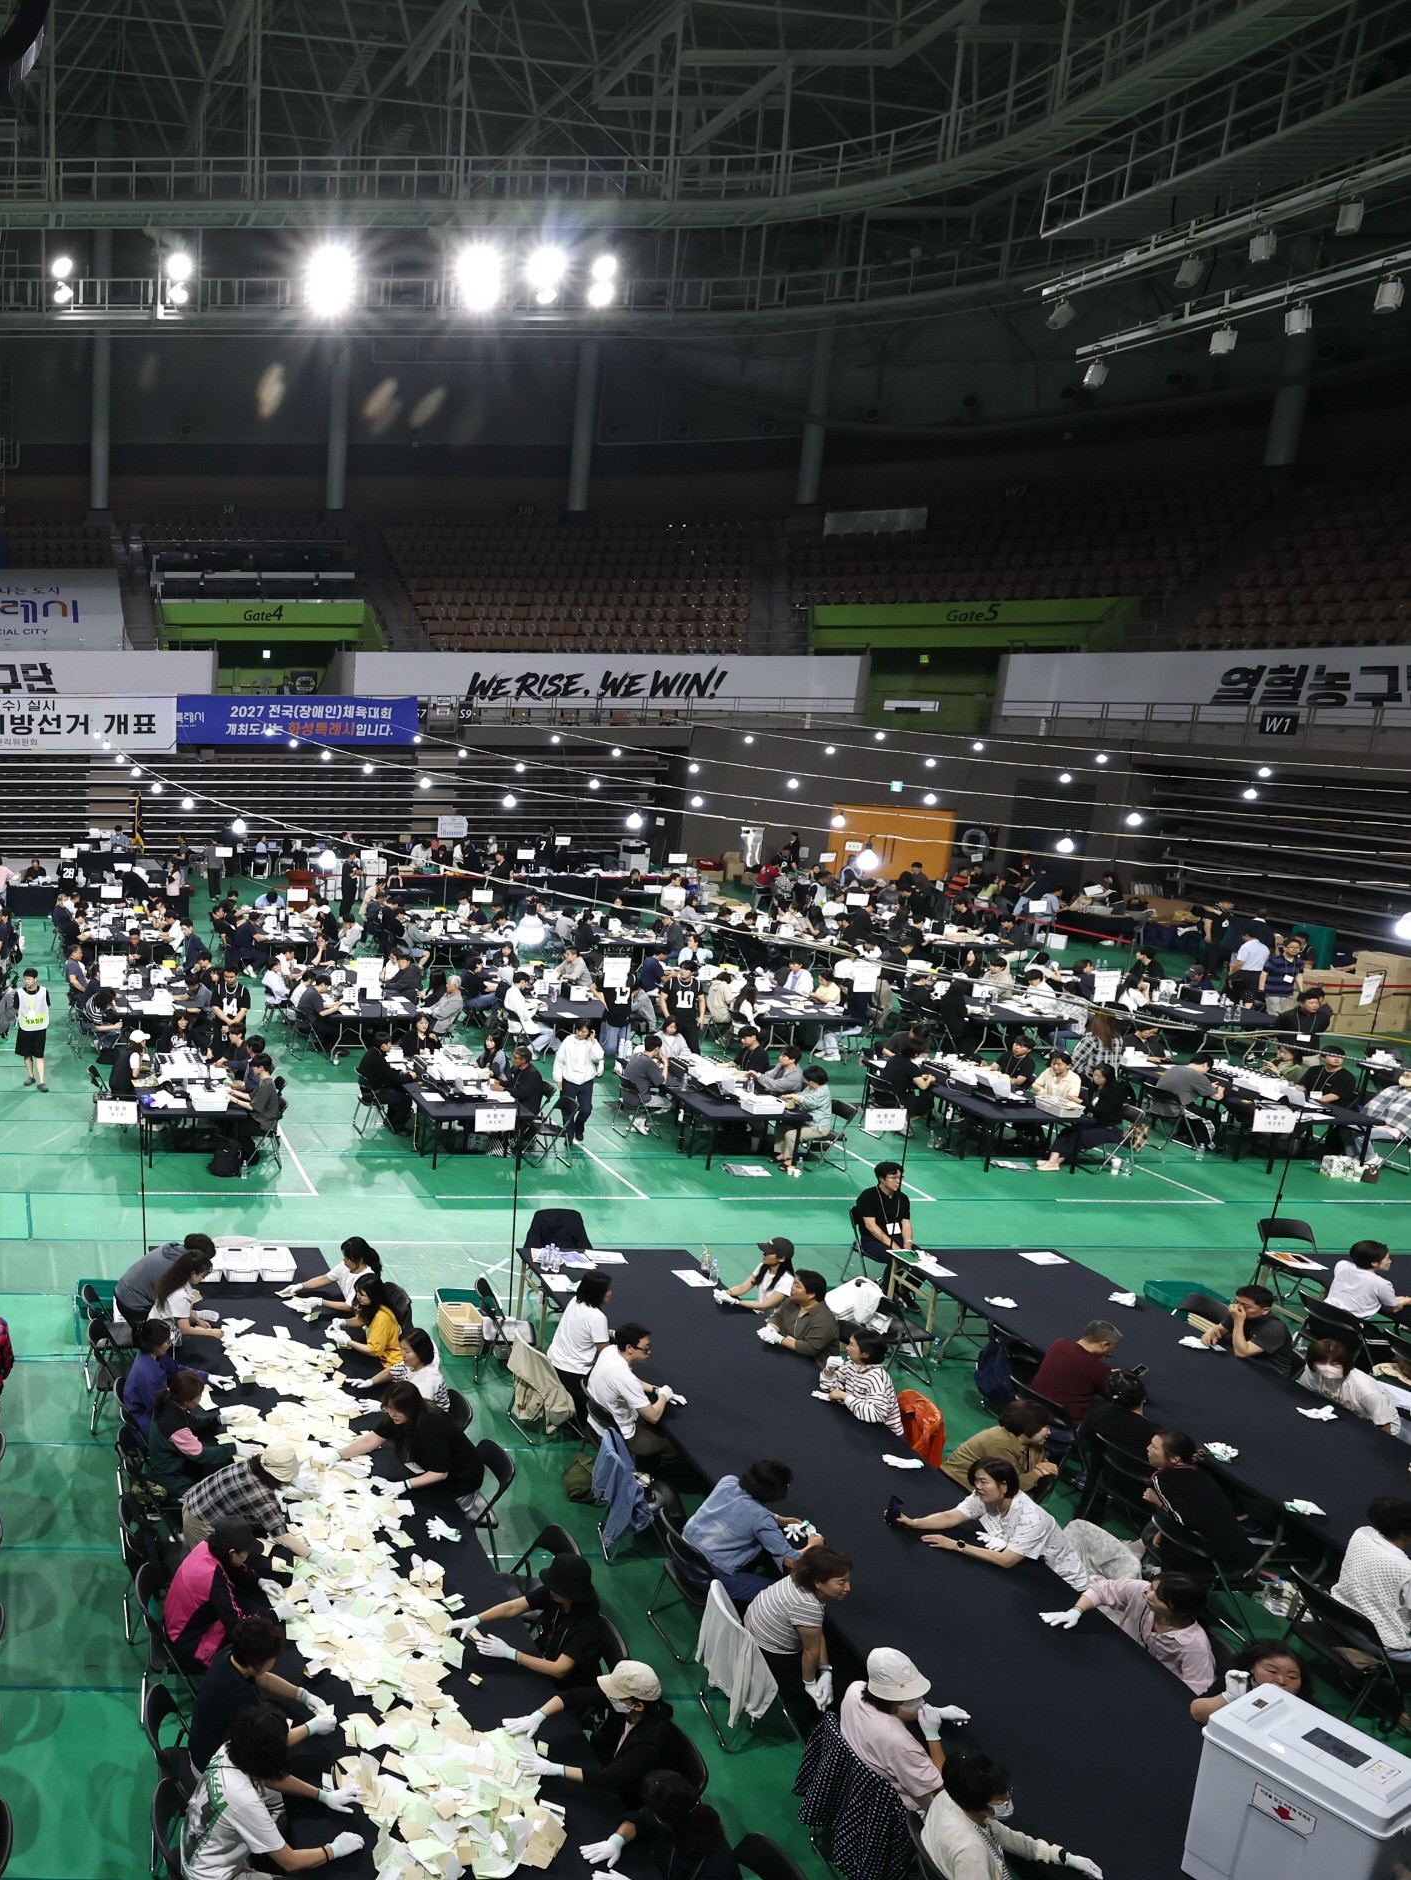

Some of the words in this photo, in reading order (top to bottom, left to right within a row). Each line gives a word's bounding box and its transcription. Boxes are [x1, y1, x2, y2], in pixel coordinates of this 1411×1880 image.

[33, 586, 61, 596] 도시
[243, 604, 284, 622] Gate4
[945, 603, 1002, 623] Gate5
[22, 628, 49, 637] CITY
[464, 669, 514, 703] WE
[513, 670, 591, 702] RISE,
[596, 669, 649, 699] WE
[649, 660, 729, 700] WIN!
[1208, 664, 1411, 707] 열혈농구
[27, 699, 56, 712] 실시
[230, 705, 265, 718] 2027
[268, 704, 393, 719] 전국(장애인)체육대회
[459, 708, 472, 719] S9
[103, 713, 157, 735] 개표
[1265, 716, 1292, 733] W1
[62, 867, 76, 879] 28
[222, 997, 239, 1017] 14
[676, 990, 695, 1009] 10
